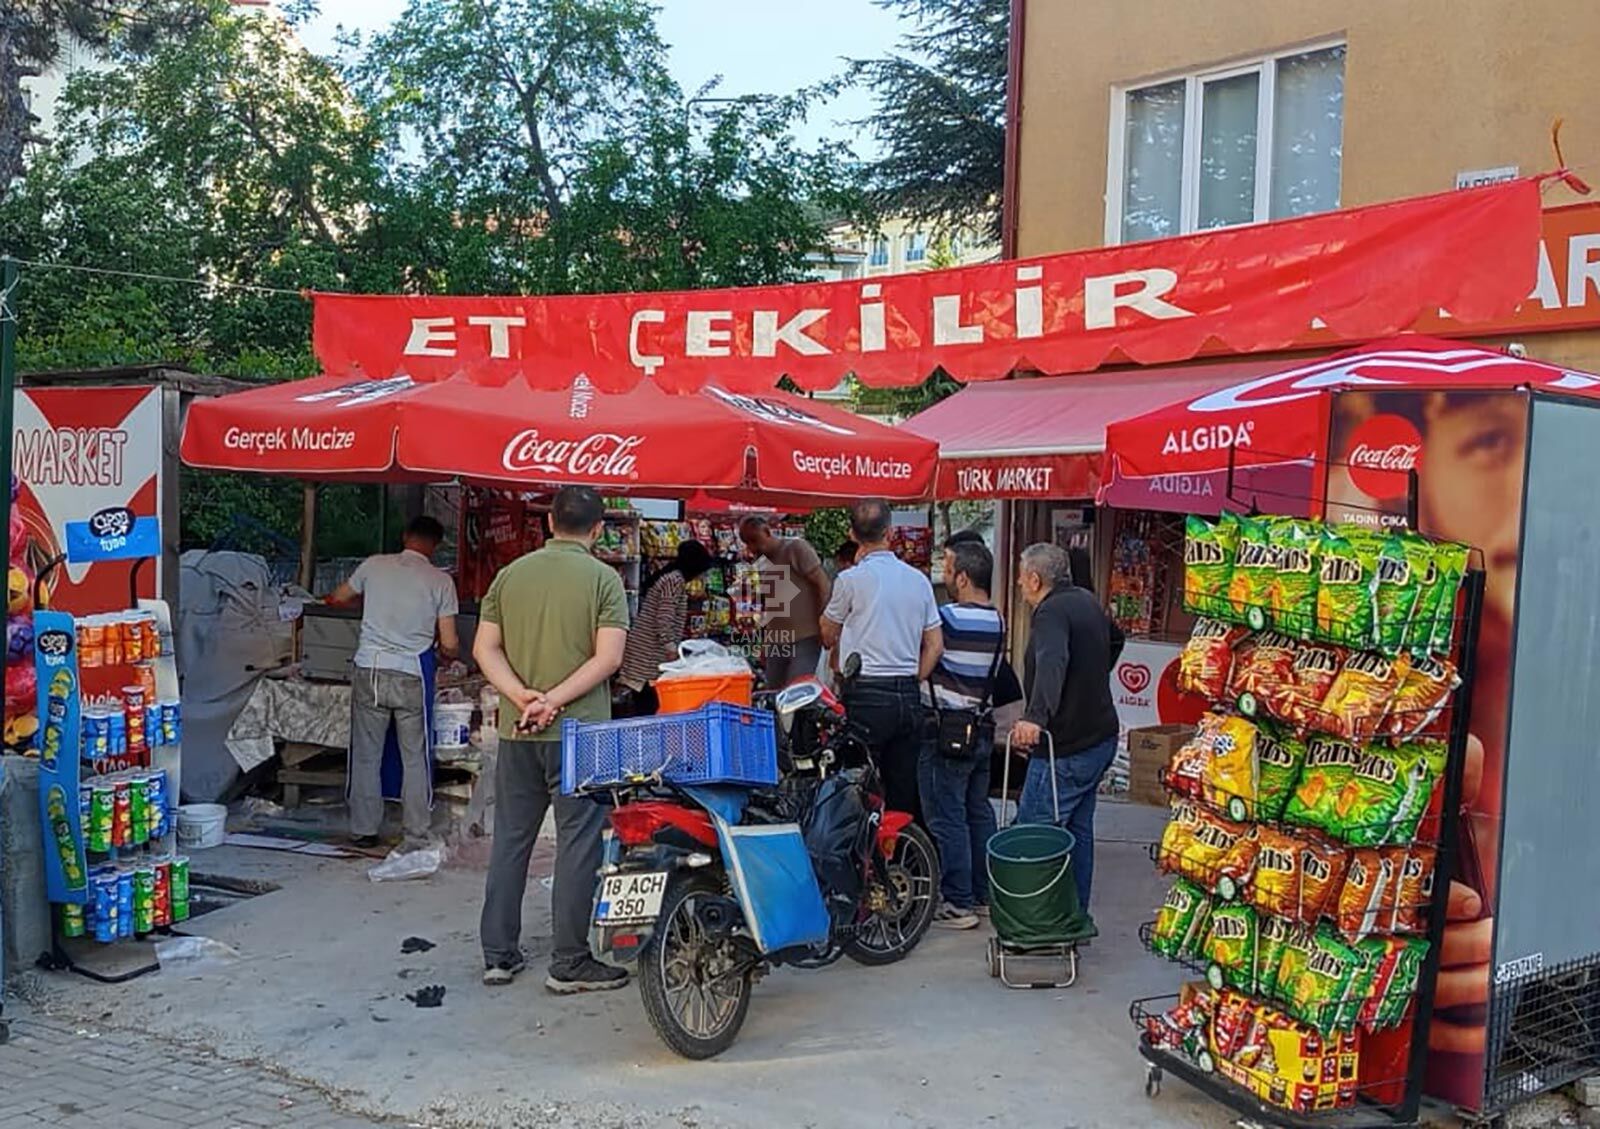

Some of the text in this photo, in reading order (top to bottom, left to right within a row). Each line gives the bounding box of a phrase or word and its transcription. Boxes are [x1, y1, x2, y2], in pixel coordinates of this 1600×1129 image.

[404, 265, 1197, 376] ET ÇEKİLİR
[224, 426, 355, 455] Gerçek Mucize
[15, 428, 128, 487] MARKET
[792, 449, 912, 480] Gerçek Mucize
[957, 466, 1053, 496] TÜRK MARKET
[606, 876, 664, 896] 18 ACH
[614, 898, 645, 916] 350
